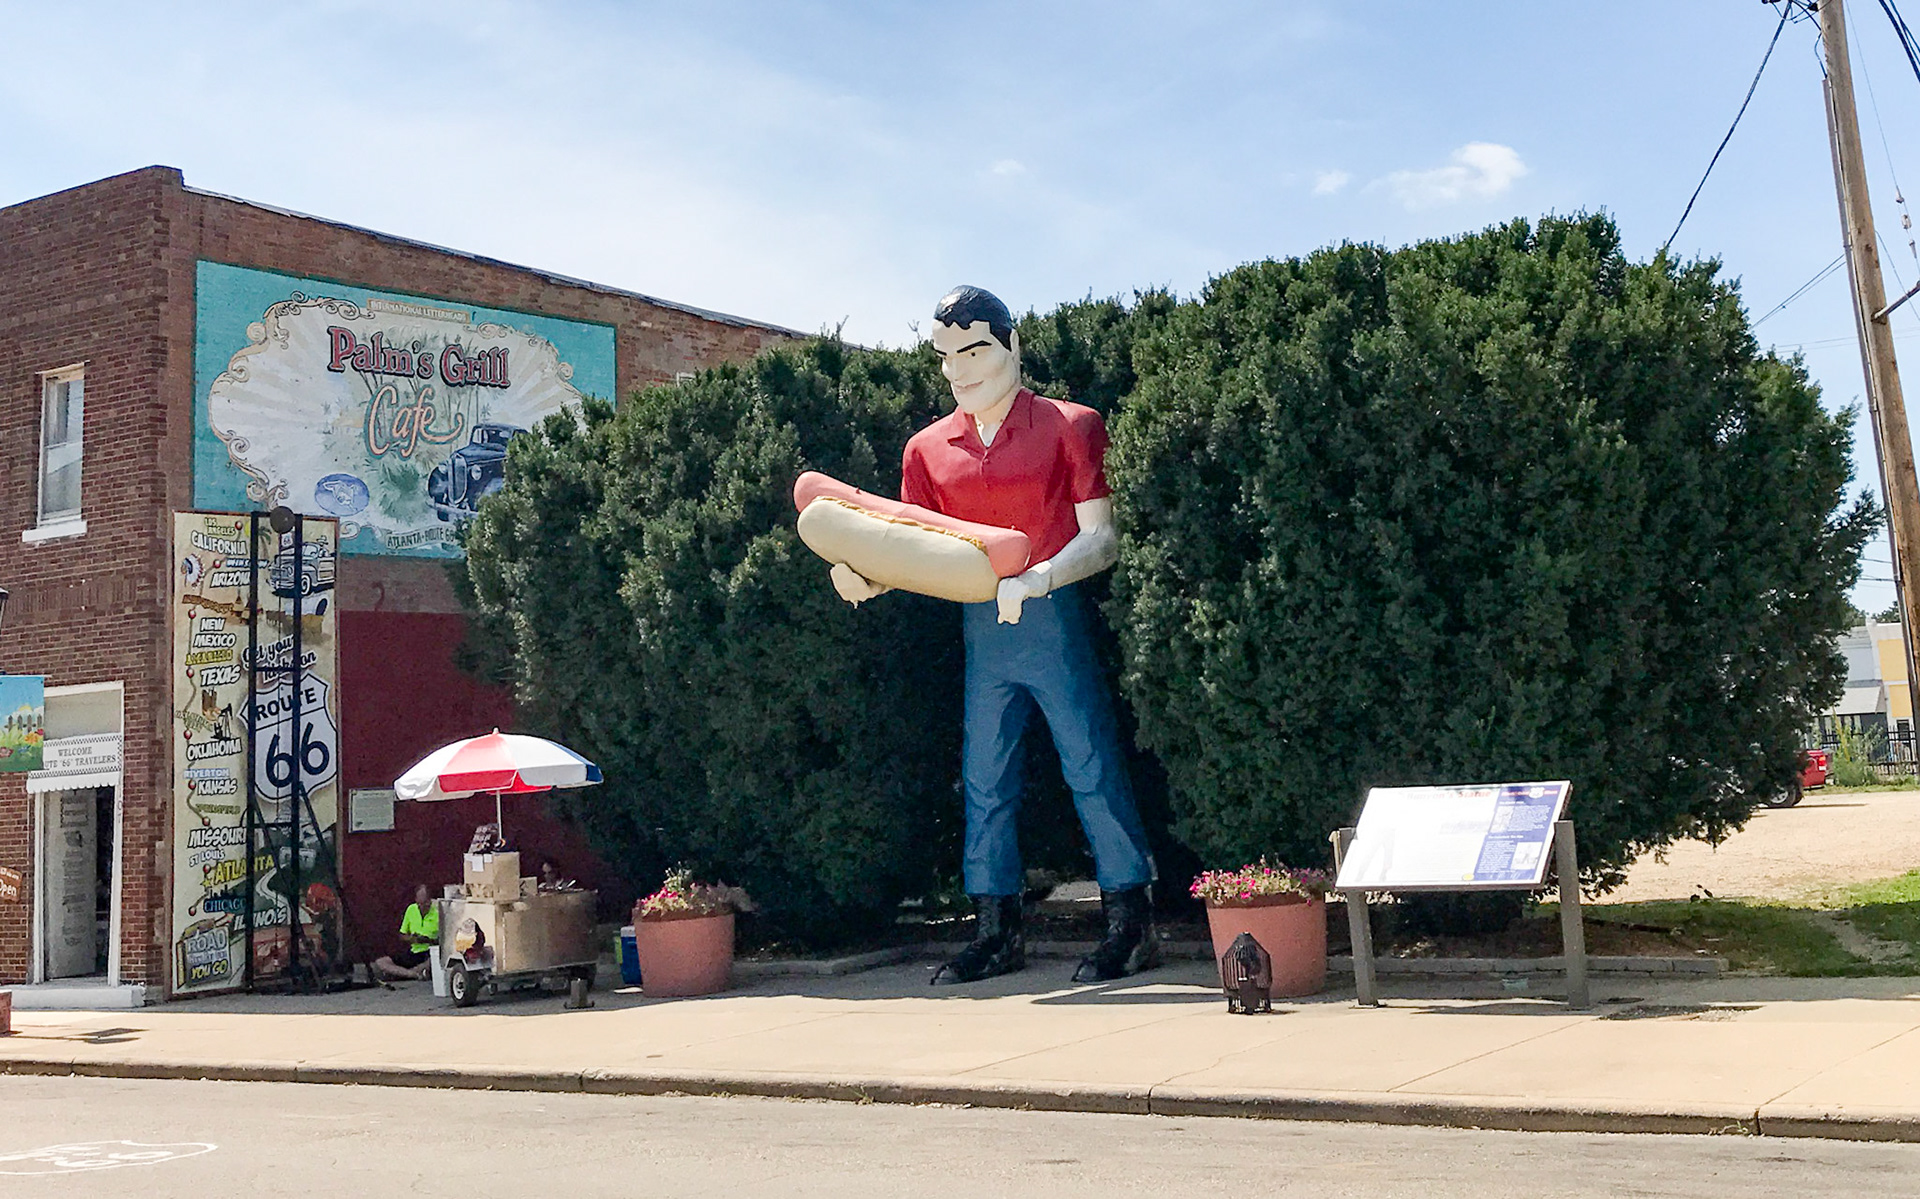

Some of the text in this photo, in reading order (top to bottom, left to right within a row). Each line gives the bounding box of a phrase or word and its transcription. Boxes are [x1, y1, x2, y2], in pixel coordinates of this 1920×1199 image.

[327, 326, 511, 389] Palm's Grill
[365, 384, 464, 458] Cafe
[191, 530, 247, 556] CALIFORNIA
[387, 532, 421, 547] ATLANTA
[210, 570, 251, 588] ARIZON
[200, 617, 227, 632] NEW
[193, 633, 237, 648] MEXICO
[267, 634, 295, 662] you
[200, 664, 241, 687] TEXAS
[58, 746, 93, 757] WELCOME
[186, 737, 242, 761] OKLAHOMA
[266, 721, 330, 788] 66
[44, 760, 58, 768] UTE
[75, 754, 116, 766] TRAVELERS
[183, 768, 231, 779] RIVERTON
[196, 778, 238, 796] KANSAS
[200, 849, 226, 863] LOUIS
[234, 907, 287, 931] ILINOIS
[187, 930, 227, 953] ROAD
[191, 963, 211, 980] YOU
[212, 959, 228, 976] GO
